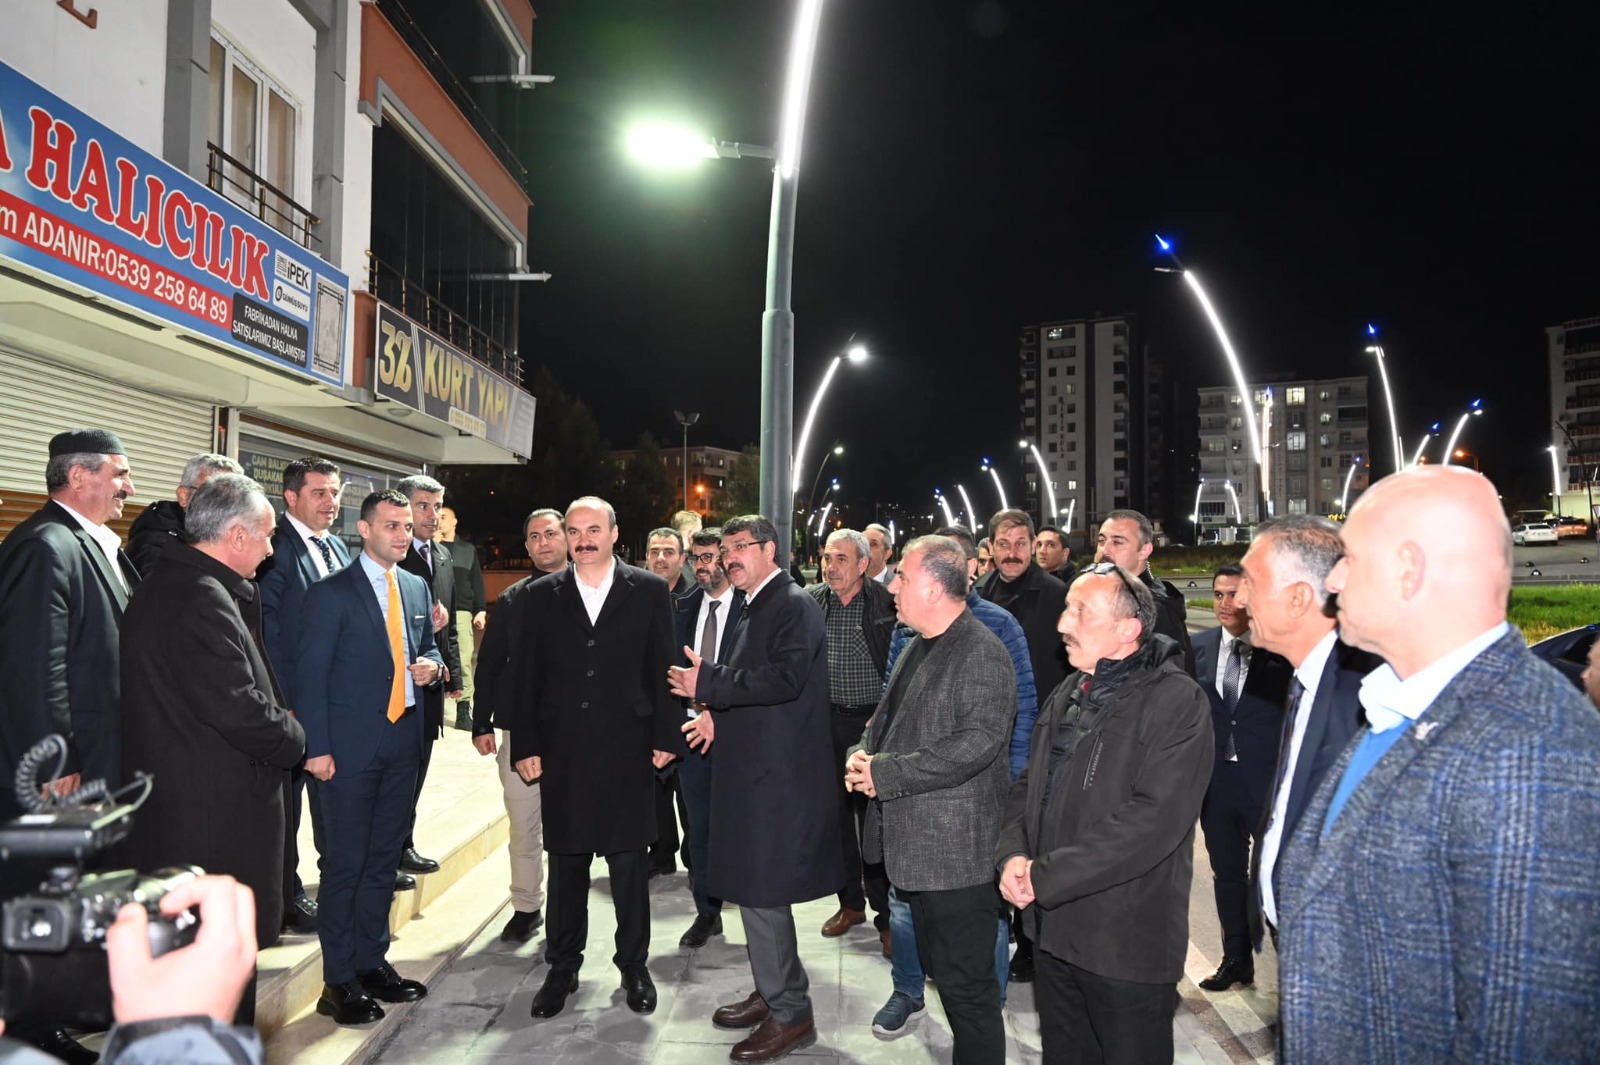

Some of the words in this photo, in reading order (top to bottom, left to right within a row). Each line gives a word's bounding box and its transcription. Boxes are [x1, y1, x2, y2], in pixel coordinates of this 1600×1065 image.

[26, 106, 270, 302] HALICILIK
[153, 271, 185, 305] 258
[188, 282, 207, 320] 64
[209, 294, 228, 324] 89
[232, 320, 272, 349] SATIŞLARIMIZ
[271, 337, 306, 363] BAŞLAMIŞTIR
[280, 321, 298, 342] HALKA
[424, 339, 474, 413] KURT
[477, 369, 510, 426] YAPI
